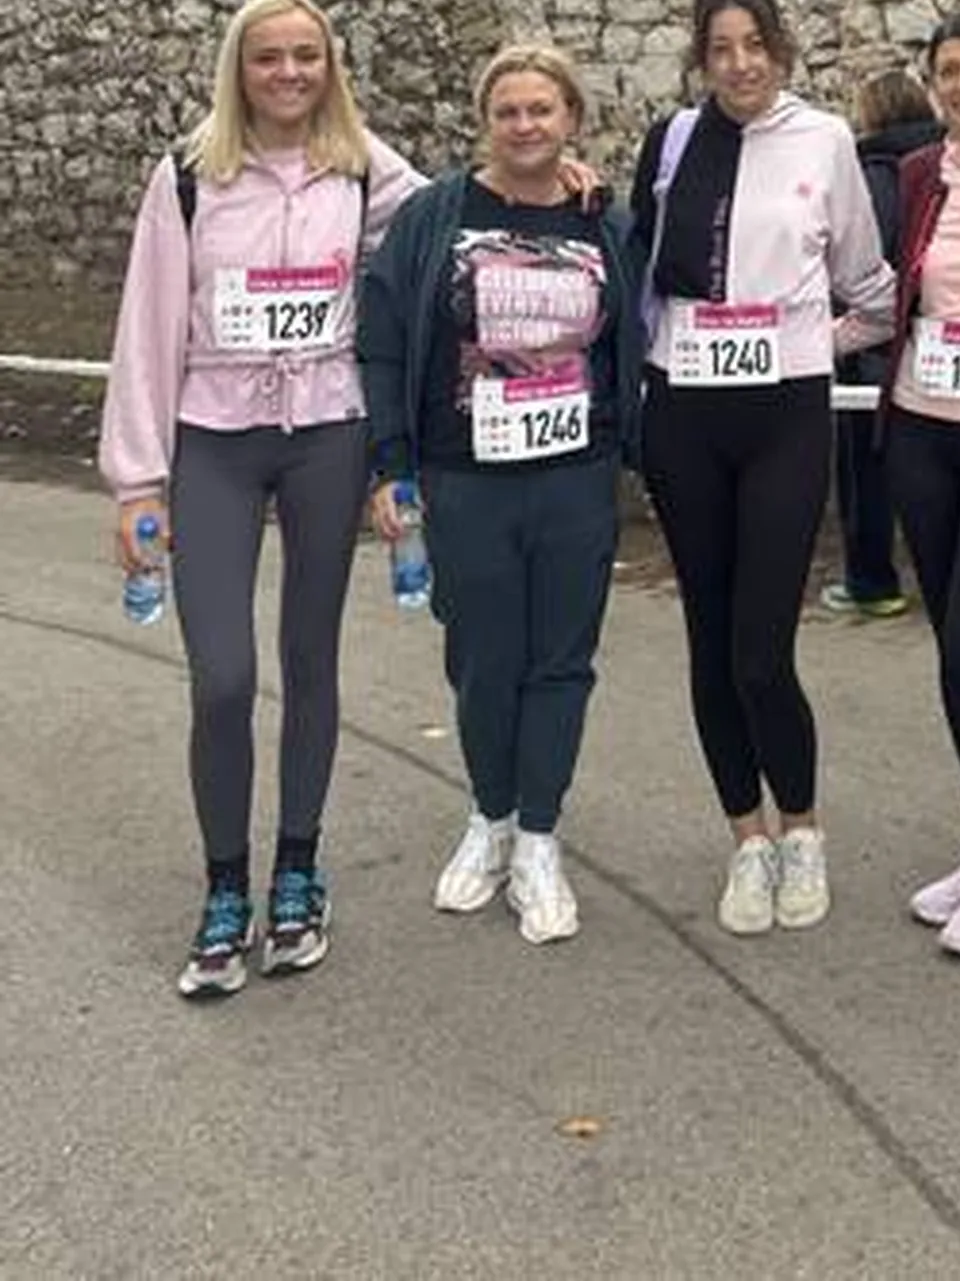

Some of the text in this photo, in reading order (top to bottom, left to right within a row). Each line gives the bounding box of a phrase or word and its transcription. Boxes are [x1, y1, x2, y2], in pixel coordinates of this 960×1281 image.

[264, 300, 329, 339] 1239
[709, 338, 772, 376] 1240
[521, 406, 581, 449] 1246
